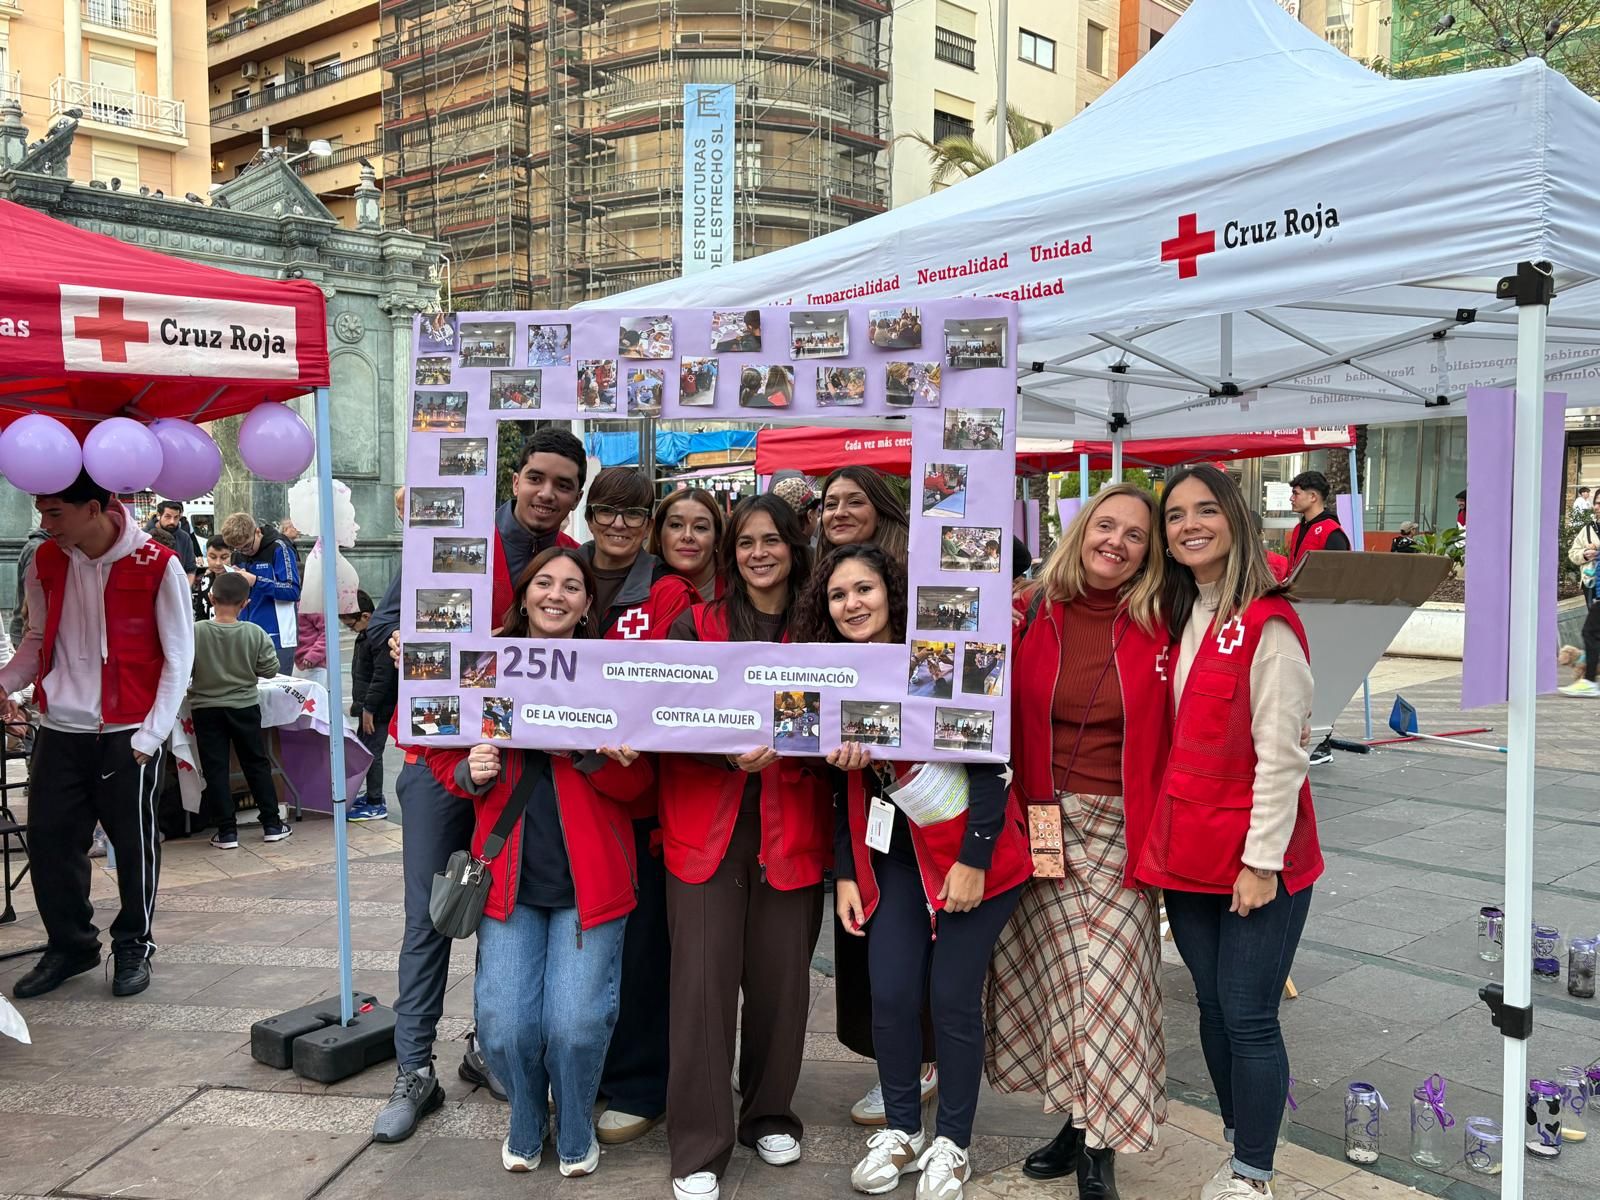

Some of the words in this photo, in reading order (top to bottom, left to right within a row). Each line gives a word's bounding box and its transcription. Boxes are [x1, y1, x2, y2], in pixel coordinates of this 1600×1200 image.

[712, 123, 724, 144] SL
[694, 138, 706, 260] ESTRUCTURAS
[711, 149, 723, 237] ESTRECHO
[1223, 220, 1277, 249] Cruz
[1284, 203, 1340, 239] Roja
[807, 275, 900, 305] Imparcialidad
[917, 252, 1009, 285] Neutralidad
[1030, 235, 1093, 263] Unidad
[160, 318, 223, 349] Cruz
[230, 324, 287, 358] Roja
[845, 439, 861, 451] Cada
[878, 436, 893, 448] más
[503, 645, 577, 682] 25N
[606, 666, 624, 678] DIA
[627, 666, 715, 681] INTERNACIONAL
[747, 670, 762, 681] DE
[764, 671, 778, 682] LA
[780, 669, 855, 684] ELIMINACIÓN
[526, 708, 539, 720] DE
[542, 709, 555, 721] LA
[557, 710, 613, 725] VIOLENCIA
[656, 710, 700, 724] CONTRA
[702, 713, 716, 725] LA
[718, 713, 756, 727] MUJER
